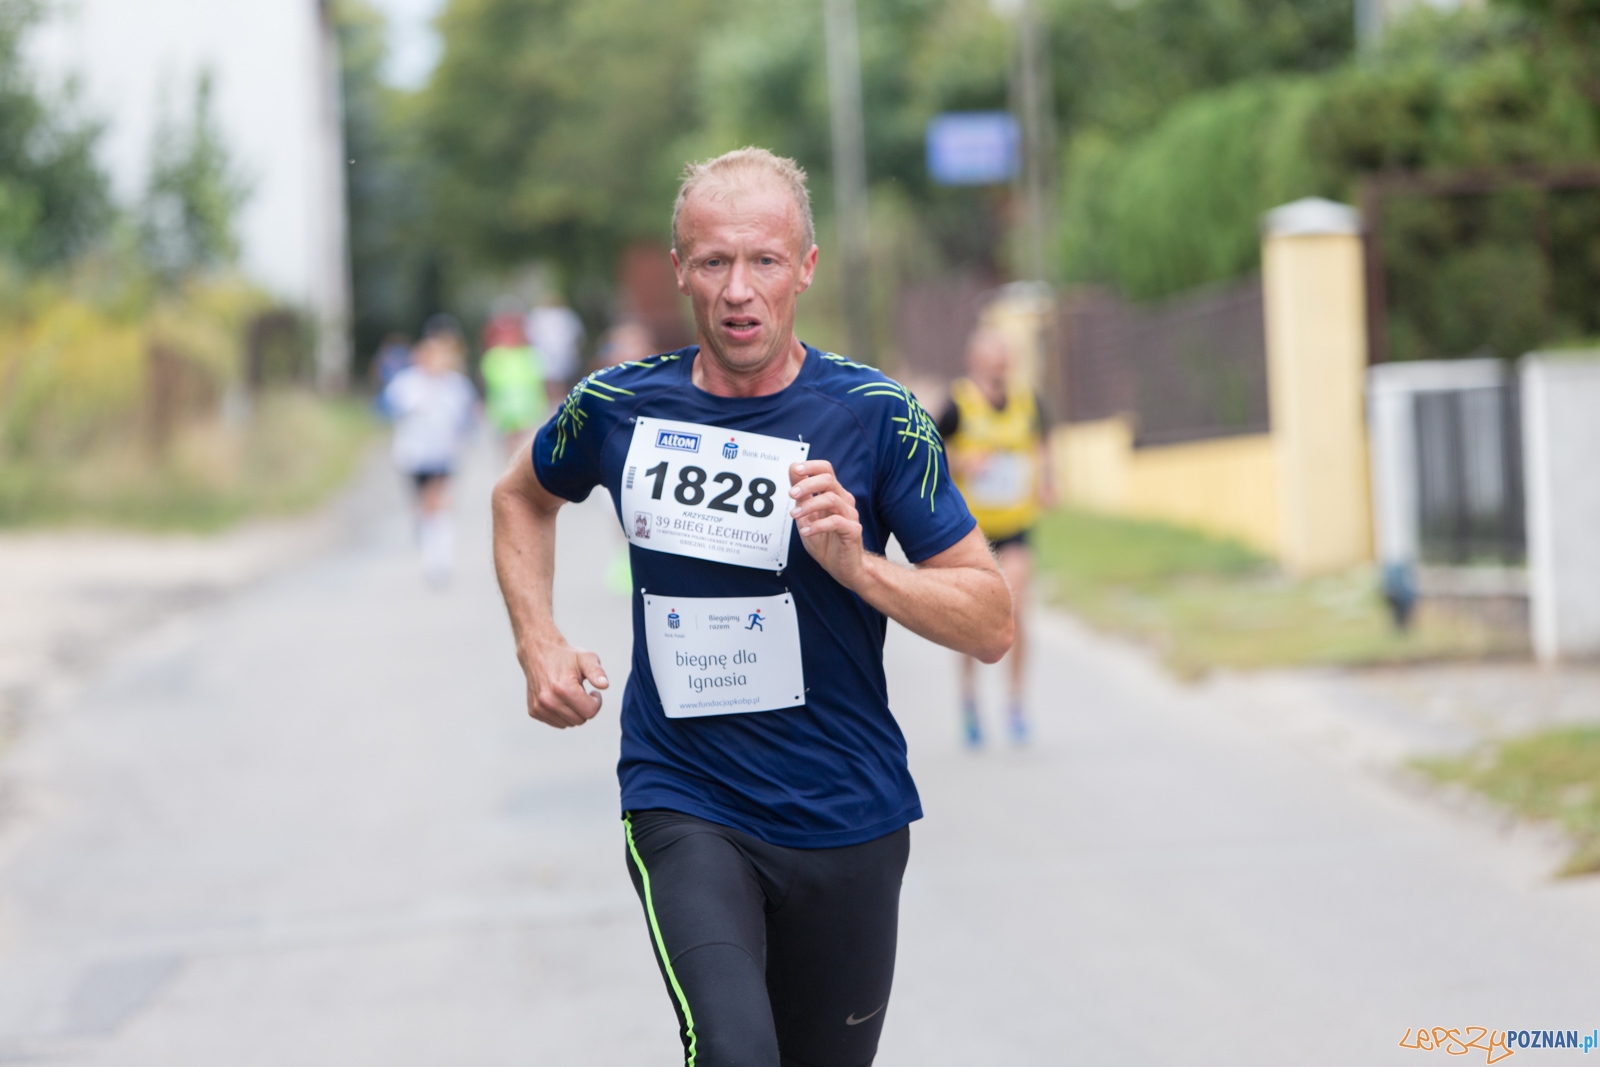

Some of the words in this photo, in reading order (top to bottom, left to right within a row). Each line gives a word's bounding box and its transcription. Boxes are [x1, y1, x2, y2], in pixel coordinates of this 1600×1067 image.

[741, 449, 758, 459] Bank
[760, 452, 780, 462] Polski
[644, 461, 777, 518] 1828
[682, 511, 724, 523] KRZYSZTOF
[655, 516, 670, 528] 39
[673, 519, 704, 534] BIEG
[707, 524, 773, 545] LECHITÓW
[675, 650, 728, 671] biegnę
[732, 649, 757, 665] dla
[688, 672, 747, 693] Ignasia
[679, 697, 760, 709] www.fundacjapkobp.pl
